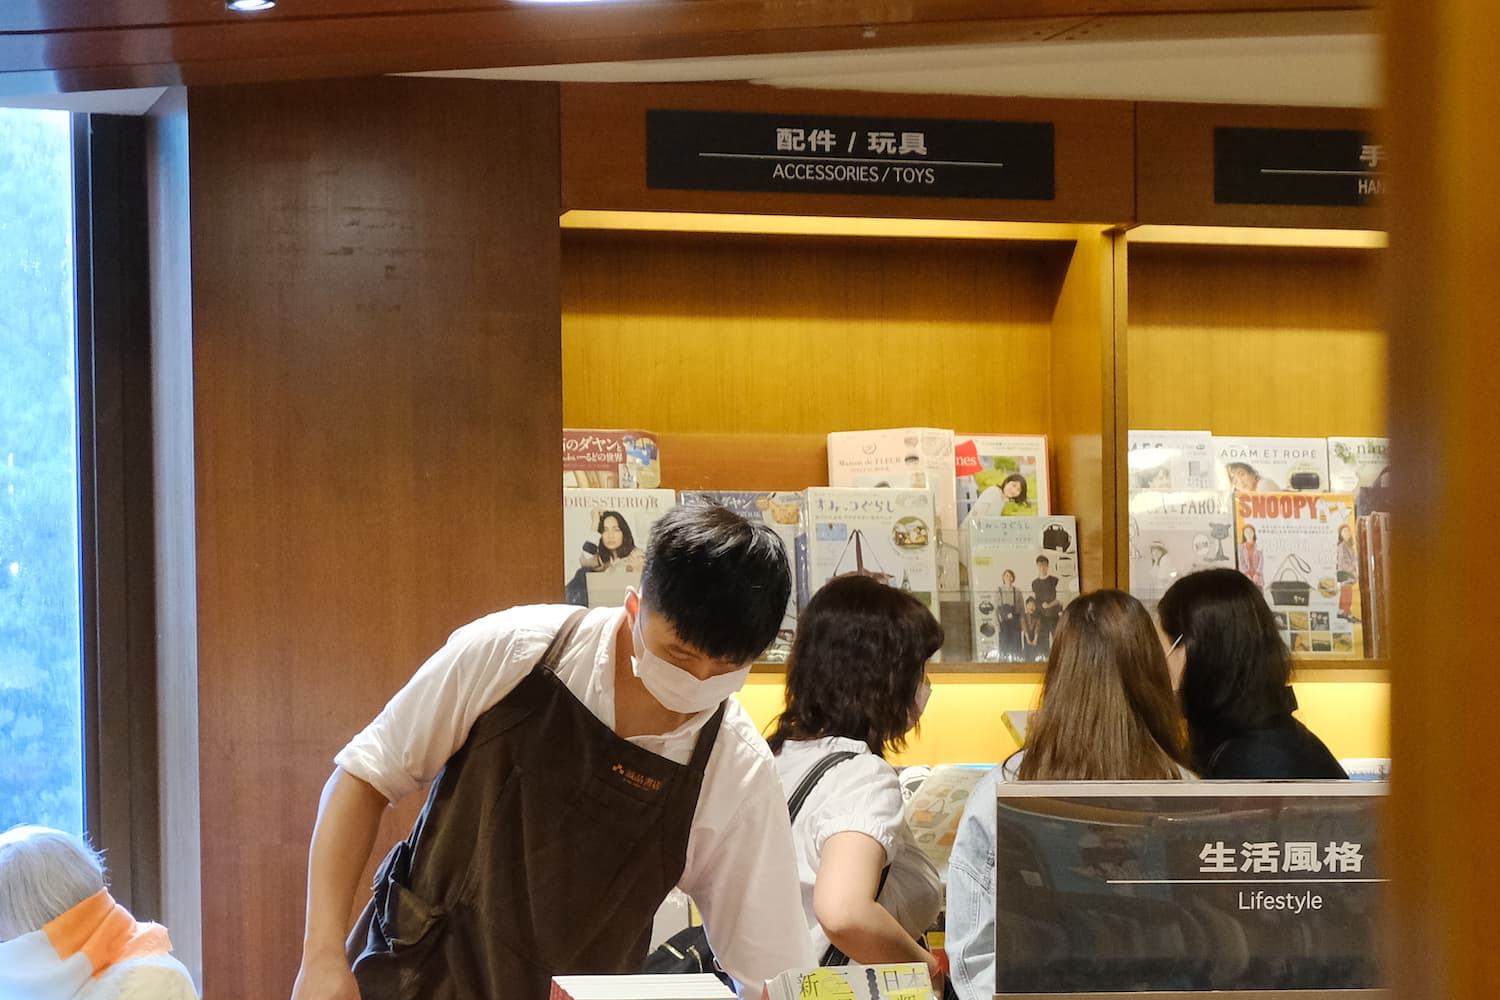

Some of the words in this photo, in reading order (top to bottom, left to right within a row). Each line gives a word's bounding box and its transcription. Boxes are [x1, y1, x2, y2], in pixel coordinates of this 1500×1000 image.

[776, 128, 837, 152] 配件
[867, 131, 928, 155] 玩具
[1220, 448, 1258, 459] ADAM
[1238, 495, 1320, 520] SNOOPY
[1198, 841, 1364, 873] 生活風格
[1237, 890, 1323, 914] Lifestyle
